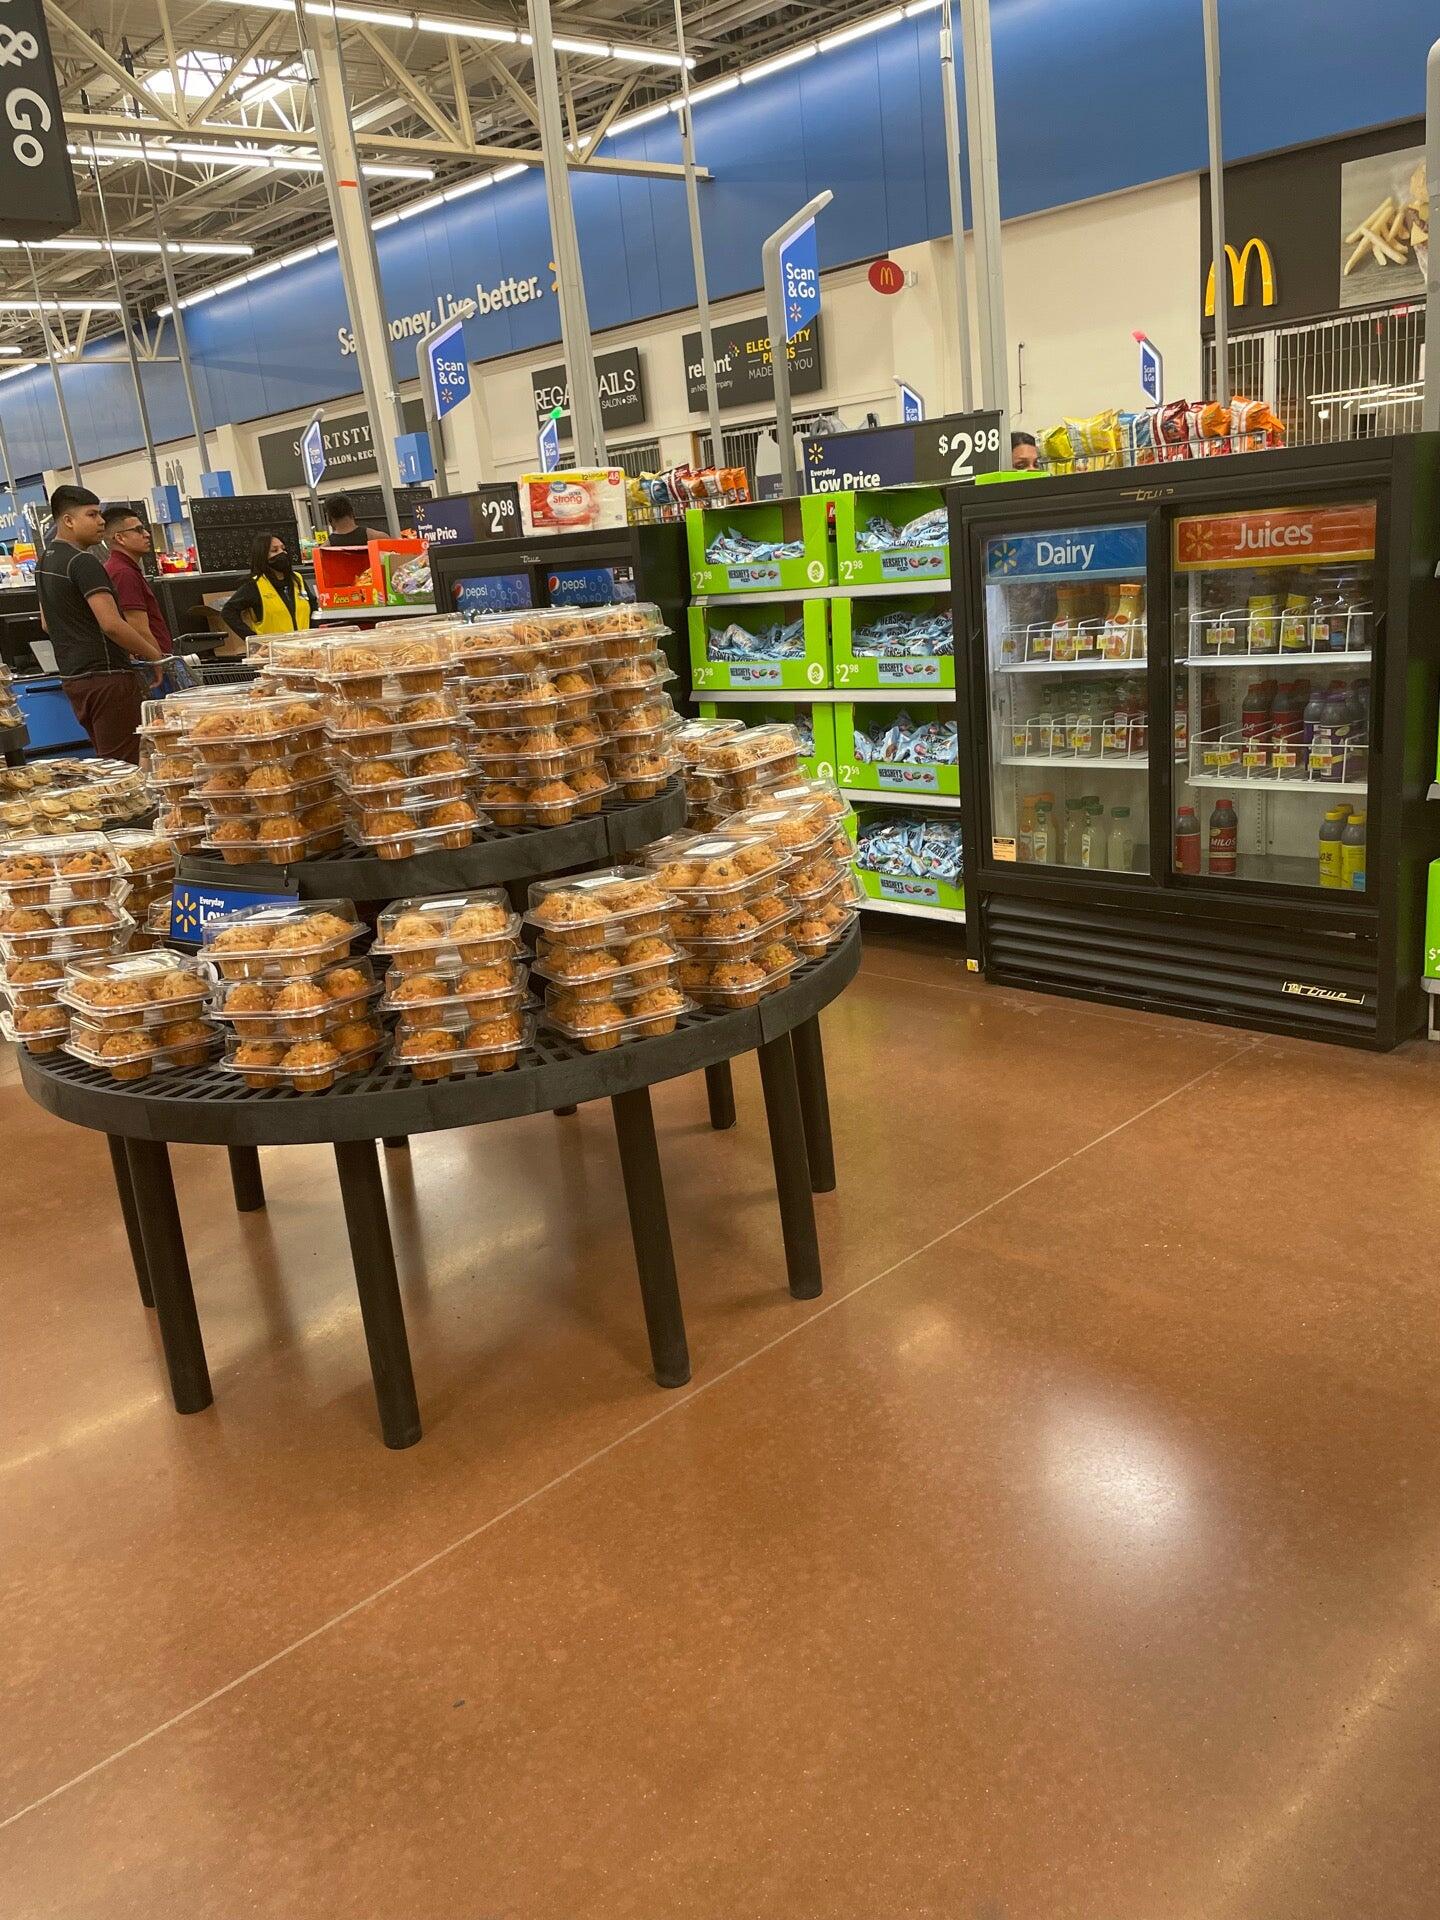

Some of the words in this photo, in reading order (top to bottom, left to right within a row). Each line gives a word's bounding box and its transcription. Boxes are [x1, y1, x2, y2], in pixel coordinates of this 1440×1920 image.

[0, 24, 39, 67] &
[5, 87, 52, 167] Go
[786, 263, 815, 281] Scan
[788, 283, 816, 298] &Go
[337, 327, 357, 356] Sa
[388, 309, 436, 342] oney.
[476, 276, 543, 315] better.
[436, 358, 464, 372] Scan
[688, 354, 732, 380] relant
[748, 365, 773, 380] MADE
[794, 356, 814, 371] YOU
[1143, 364, 1156, 373] Scan
[439, 372, 466, 386] &Go
[534, 385, 570, 411] REGA
[598, 368, 636, 399] AILS
[601, 398, 622, 409] SALON
[544, 441, 556, 449] Scan
[328, 453, 352, 466] SALON
[810, 468, 836, 477] Everyday
[810, 477, 840, 493] Low
[843, 470, 880, 490] Price
[552, 494, 583, 505] Strong
[436, 526, 458, 540] Price
[1234, 521, 1314, 552] Juices
[1036, 539, 1095, 571] Dairy
[465, 584, 488, 600] pepsi
[561, 576, 587, 594] pepsi
[200, 896, 225, 908] Everyday
